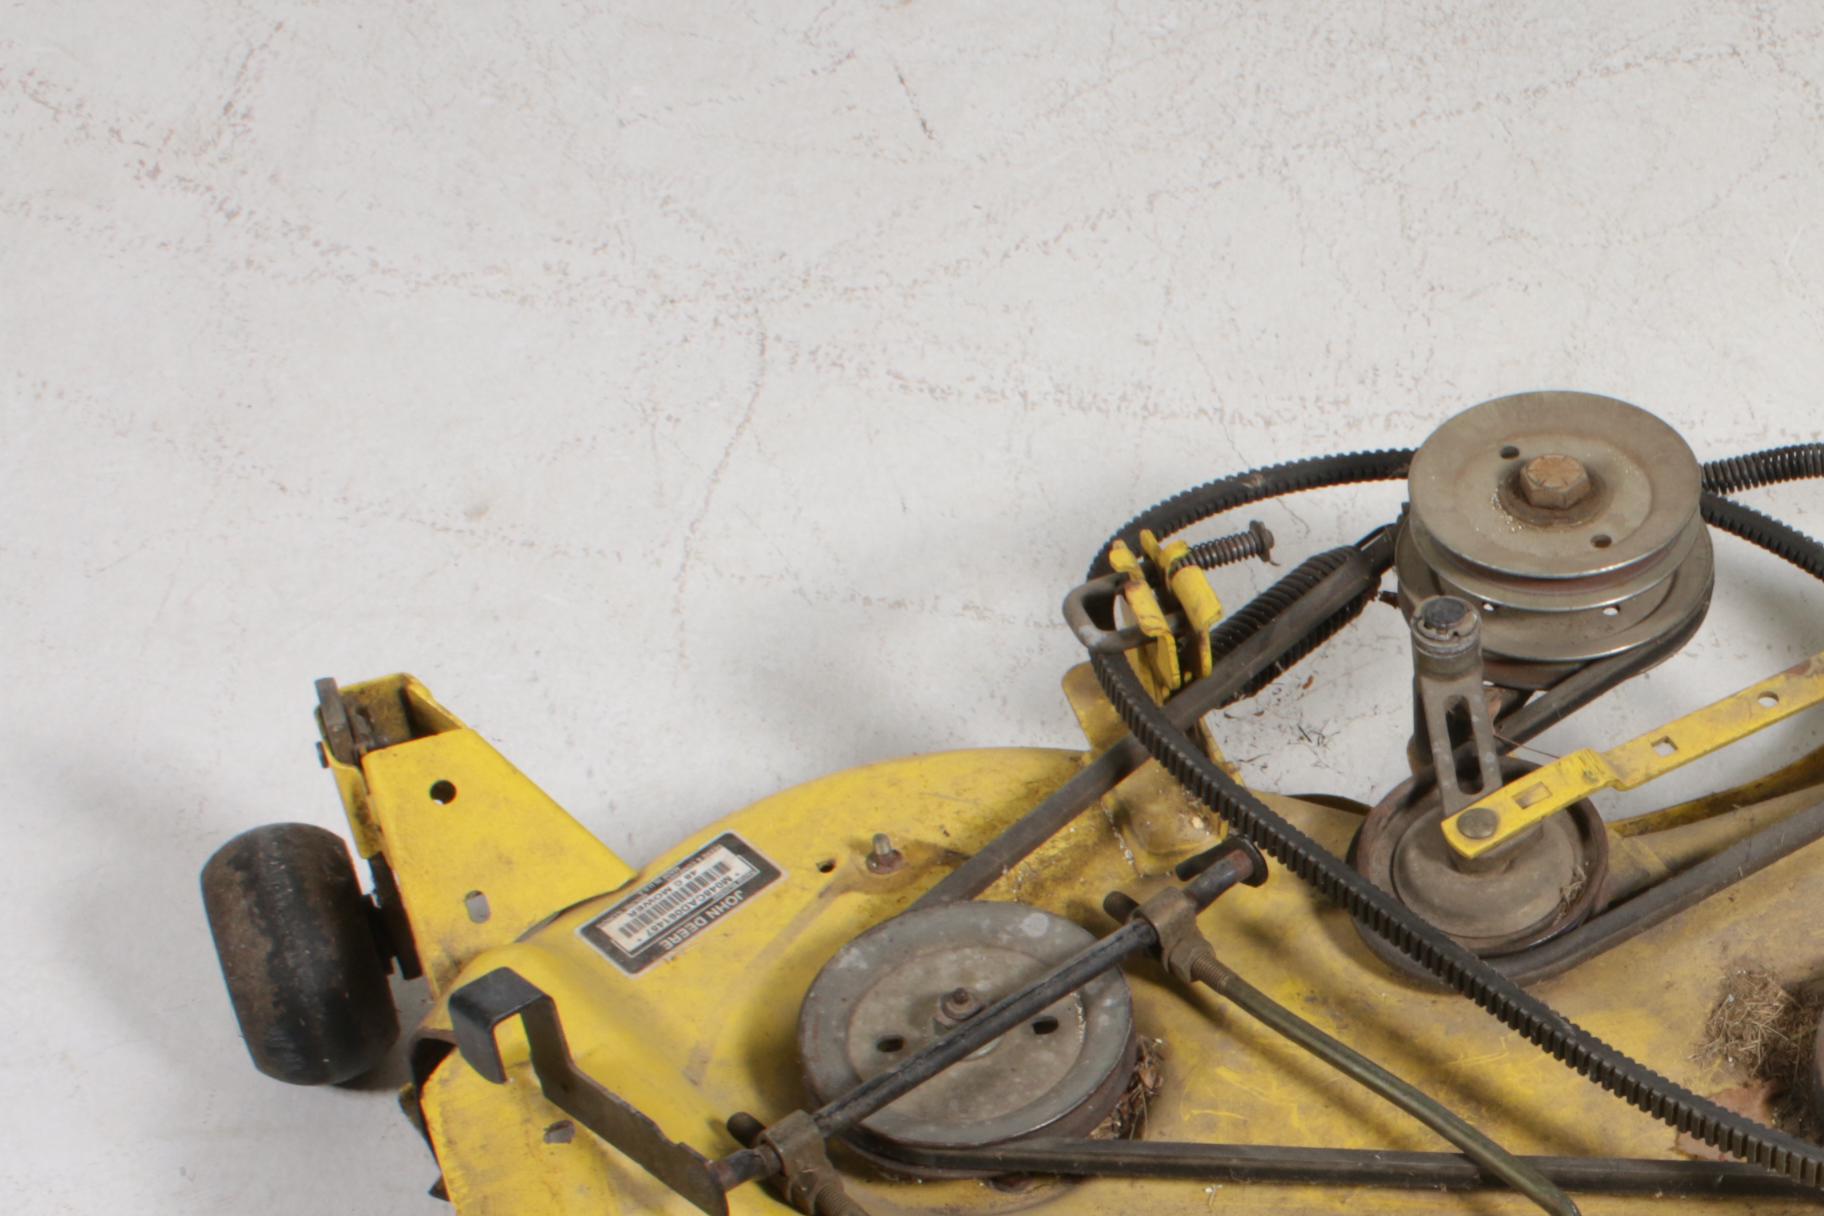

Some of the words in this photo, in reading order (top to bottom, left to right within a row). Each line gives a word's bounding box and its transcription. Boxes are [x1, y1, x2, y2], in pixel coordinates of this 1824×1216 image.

[628, 886, 673, 917] MOWER
[704, 889, 744, 919] JOHN
[659, 916, 708, 950] DEERE
